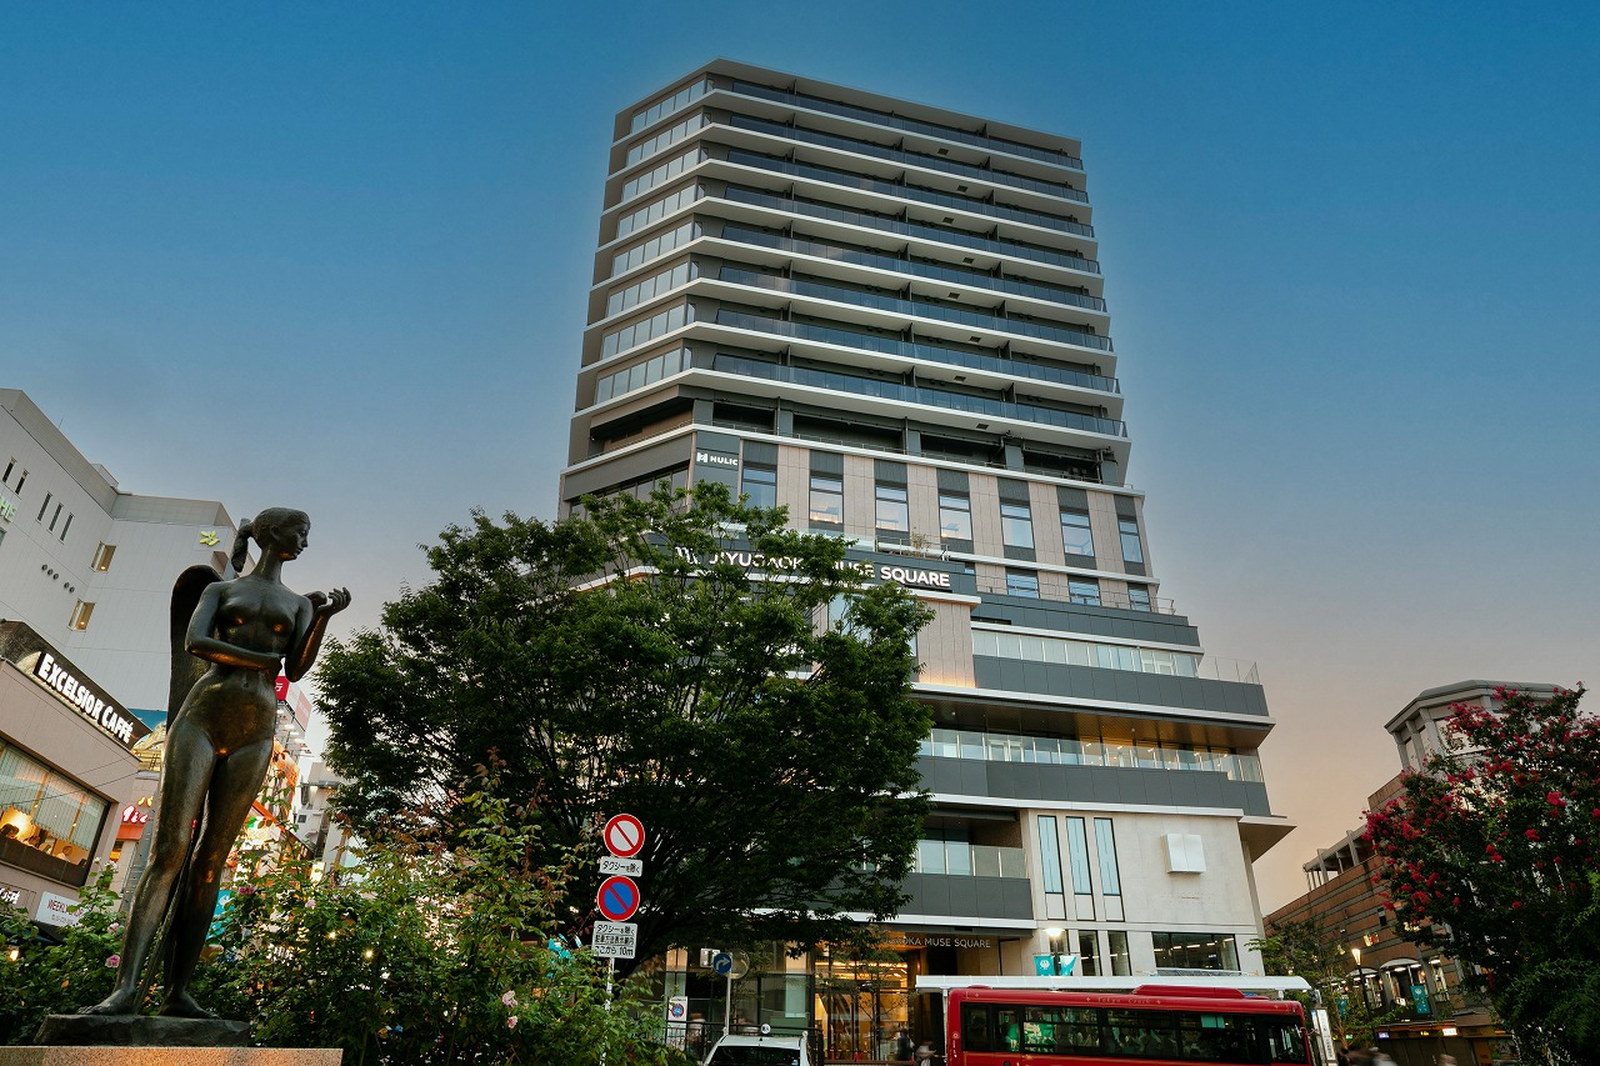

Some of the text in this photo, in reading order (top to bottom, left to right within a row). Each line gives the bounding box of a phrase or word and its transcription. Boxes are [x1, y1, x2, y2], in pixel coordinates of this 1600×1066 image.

[710, 455, 739, 466] HULIC
[880, 566, 951, 587] SQUARE
[38, 652, 134, 744] EXCELSIOR CAFFÉ
[924, 938, 952, 947] MUSE
[954, 939, 991, 949] SQUARE
